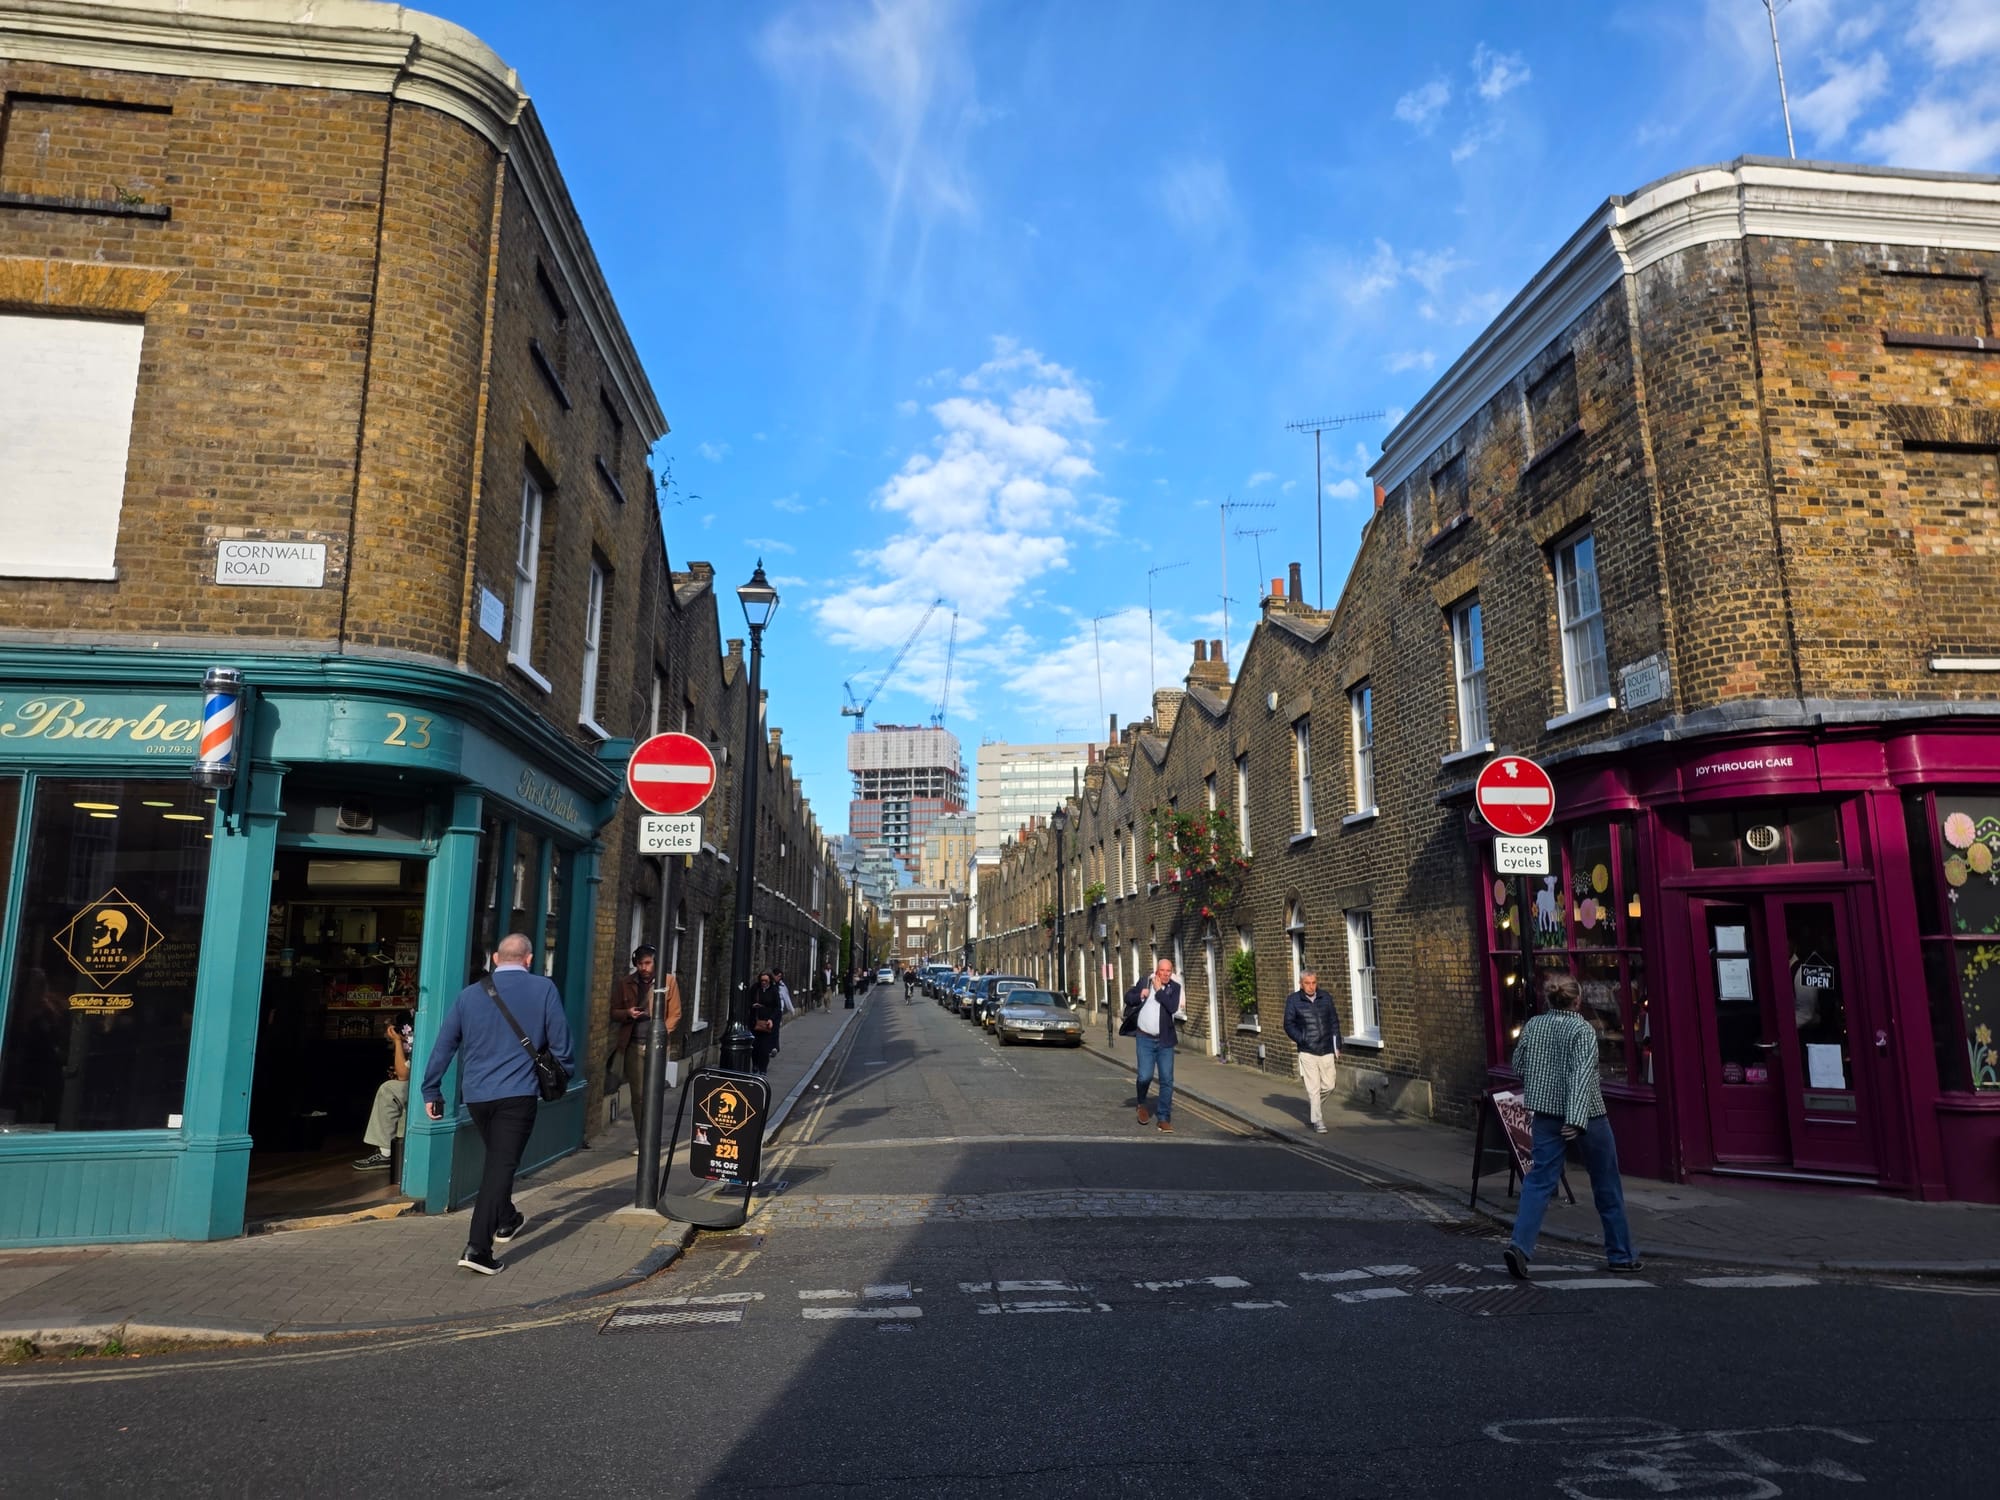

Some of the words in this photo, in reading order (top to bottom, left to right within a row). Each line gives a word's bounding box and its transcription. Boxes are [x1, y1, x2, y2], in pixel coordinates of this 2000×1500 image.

[225, 545, 318, 560] CORNWALL
[225, 562, 270, 575] ROAD
[1627, 669, 1656, 688] ROUPELL
[1628, 684, 1651, 700] STREET
[383, 712, 433, 749] 23
[146, 745, 166, 754] 020
[168, 745, 193, 754] 7928
[1695, 765, 1710, 777] JOY
[1711, 759, 1763, 774] THROUGH
[1765, 757, 1794, 768] CAKE
[518, 767, 547, 806] First
[546, 783, 578, 825] Barber
[647, 821, 696, 834] Except
[648, 836, 692, 848] cycles
[1501, 842, 1544, 856] Except
[1503, 857, 1542, 869] cycles
[85, 955, 128, 963] BARBER
[1806, 975, 1829, 988] OPEN
[105, 997, 131, 1008] Shop
[716, 1144, 738, 1160] £24
[723, 1162, 738, 1170] OFF
